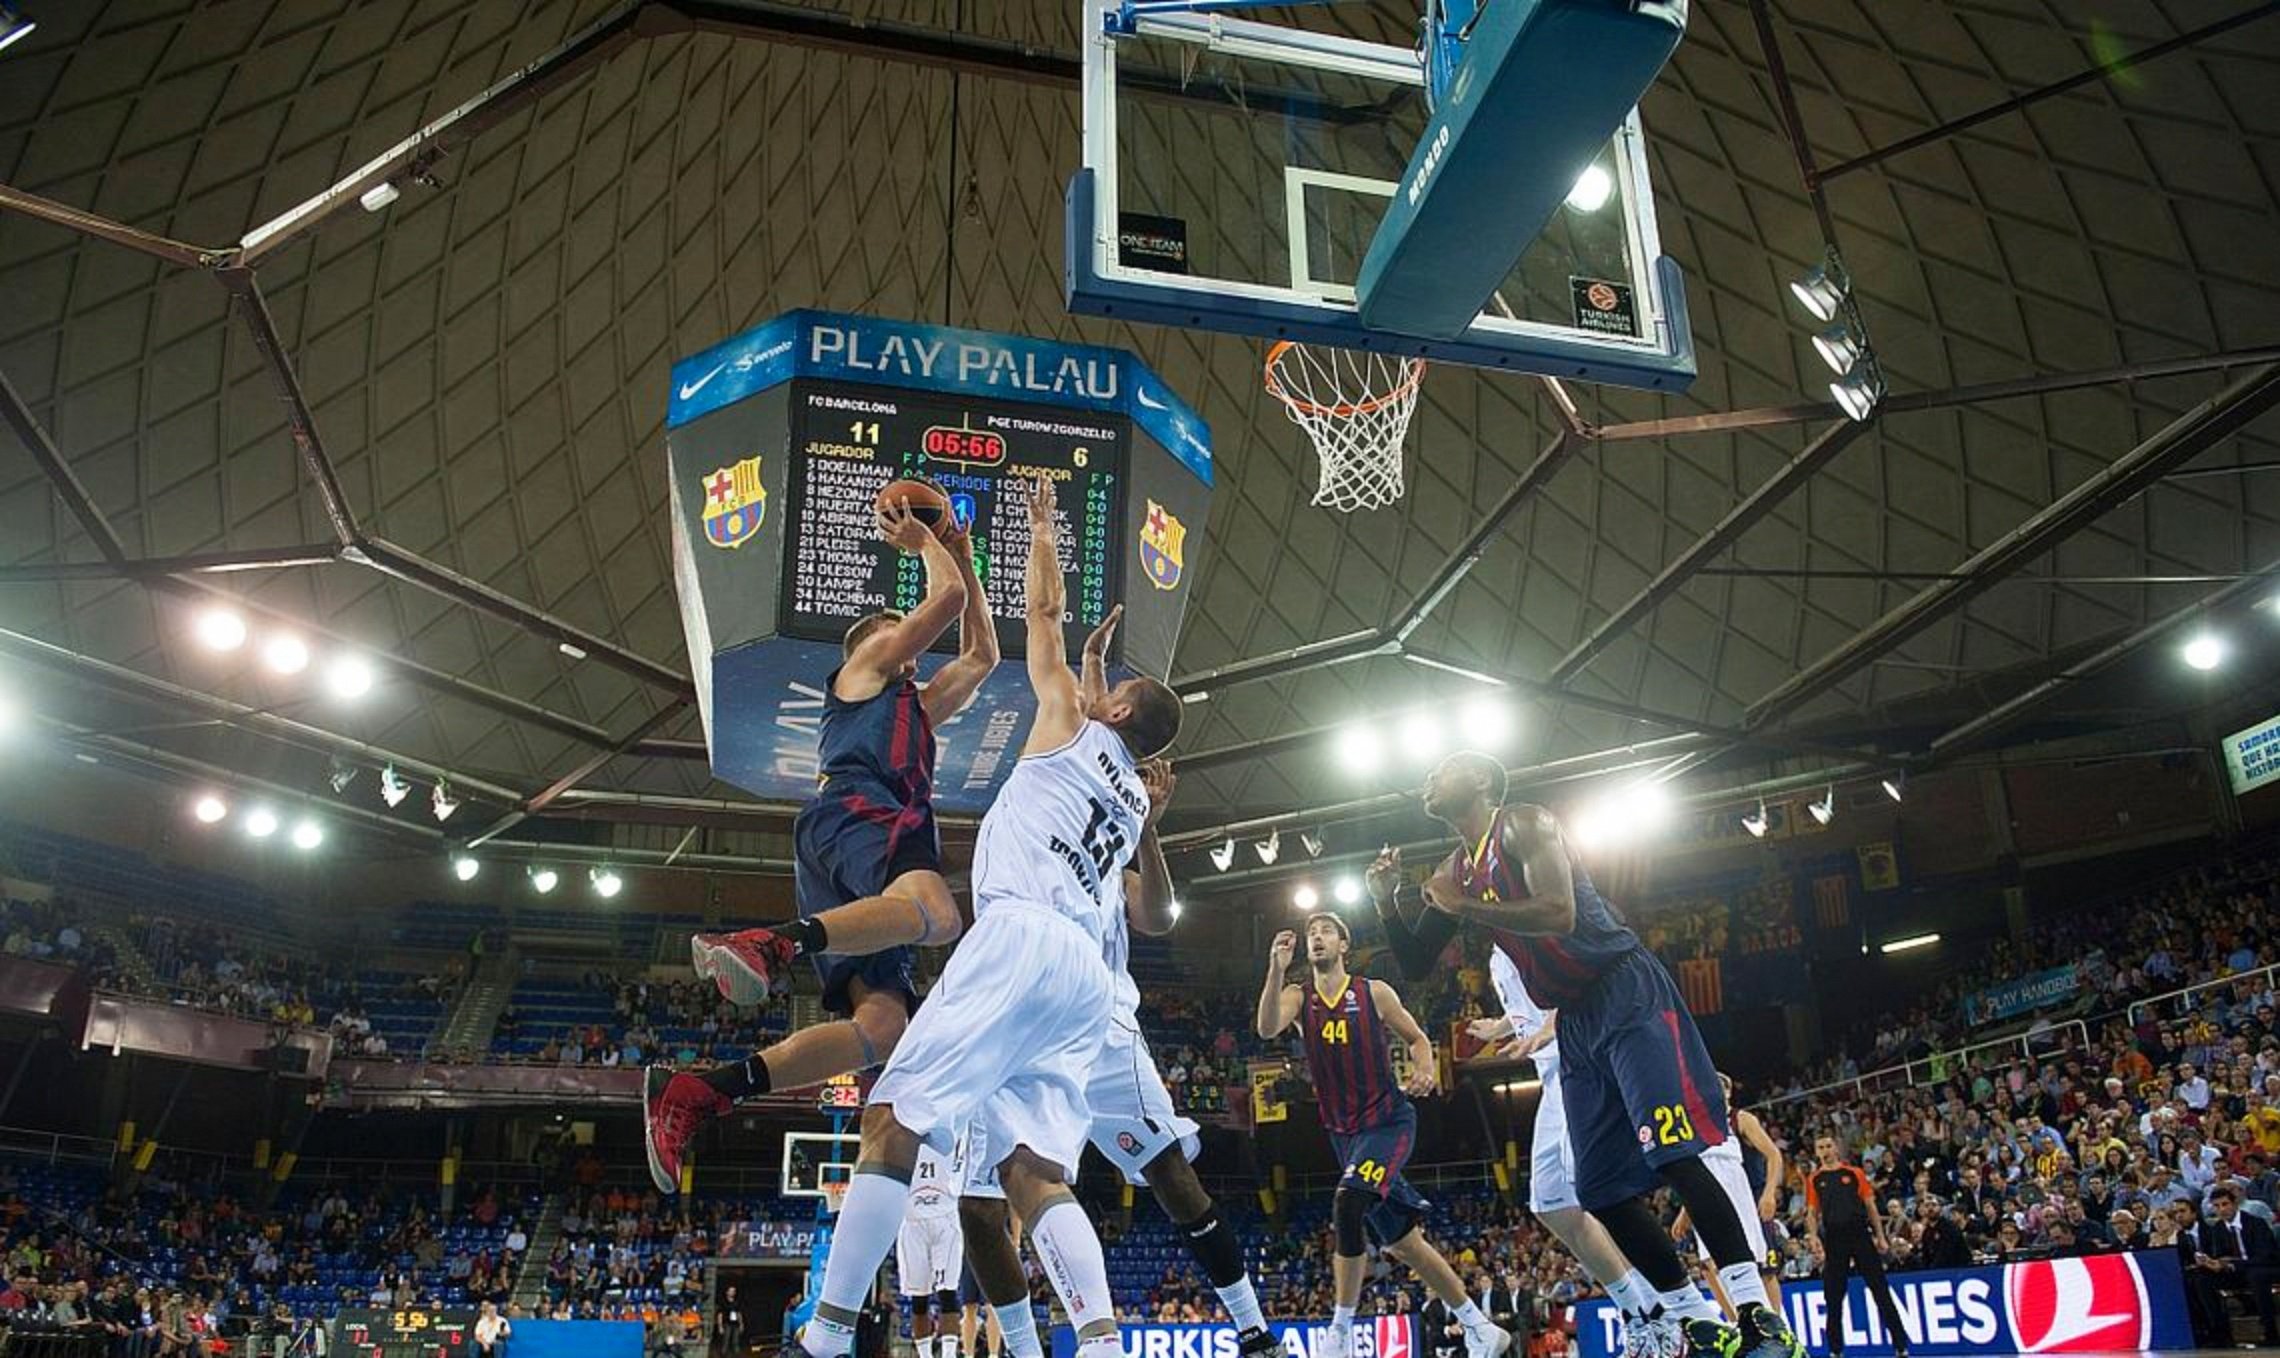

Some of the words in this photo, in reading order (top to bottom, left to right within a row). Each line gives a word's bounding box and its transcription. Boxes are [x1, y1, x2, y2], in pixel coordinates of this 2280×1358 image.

[1408, 125, 1449, 206] MONDO
[1581, 309, 1631, 323] TURKISH
[810, 325, 944, 377] PLAY
[958, 344, 1118, 399] PALAU
[850, 421, 880, 444] 11
[805, 442, 874, 460] JUGADOR
[928, 431, 1001, 458] 05:56
[1073, 447, 1089, 468] 6
[807, 471, 816, 483] 6
[817, 460, 894, 478] DOELLMAN
[806, 484, 815, 495] 8
[933, 473, 991, 491] PERIODE
[817, 498, 872, 514] HUERTA
[801, 510, 815, 521] 10
[801, 523, 814, 535] 13
[817, 523, 886, 541] SATORAN
[800, 536, 814, 547] 21
[816, 537, 860, 552] PLEISS
[798, 548, 816, 561] 23
[817, 549, 878, 567] THOMAS
[798, 562, 814, 573] 24
[818, 563, 873, 579] OLESON
[796, 575, 814, 587] 30
[816, 577, 864, 592] LAMPE
[796, 587, 813, 599] 34
[815, 590, 886, 607] NACHBAR
[795, 601, 812, 613] 44
[814, 602, 861, 617] TOMIC
[1081, 797, 1125, 882] 13
[1322, 1019, 1348, 1044] 44
[1654, 1103, 1695, 1146] 23
[919, 1161, 935, 1179] 21
[1358, 1159, 1385, 1187] 44
[749, 1231, 792, 1247] PLAY
[1782, 1279, 1997, 1349] IRLINES
[1117, 1328, 1240, 1358] URKIS
